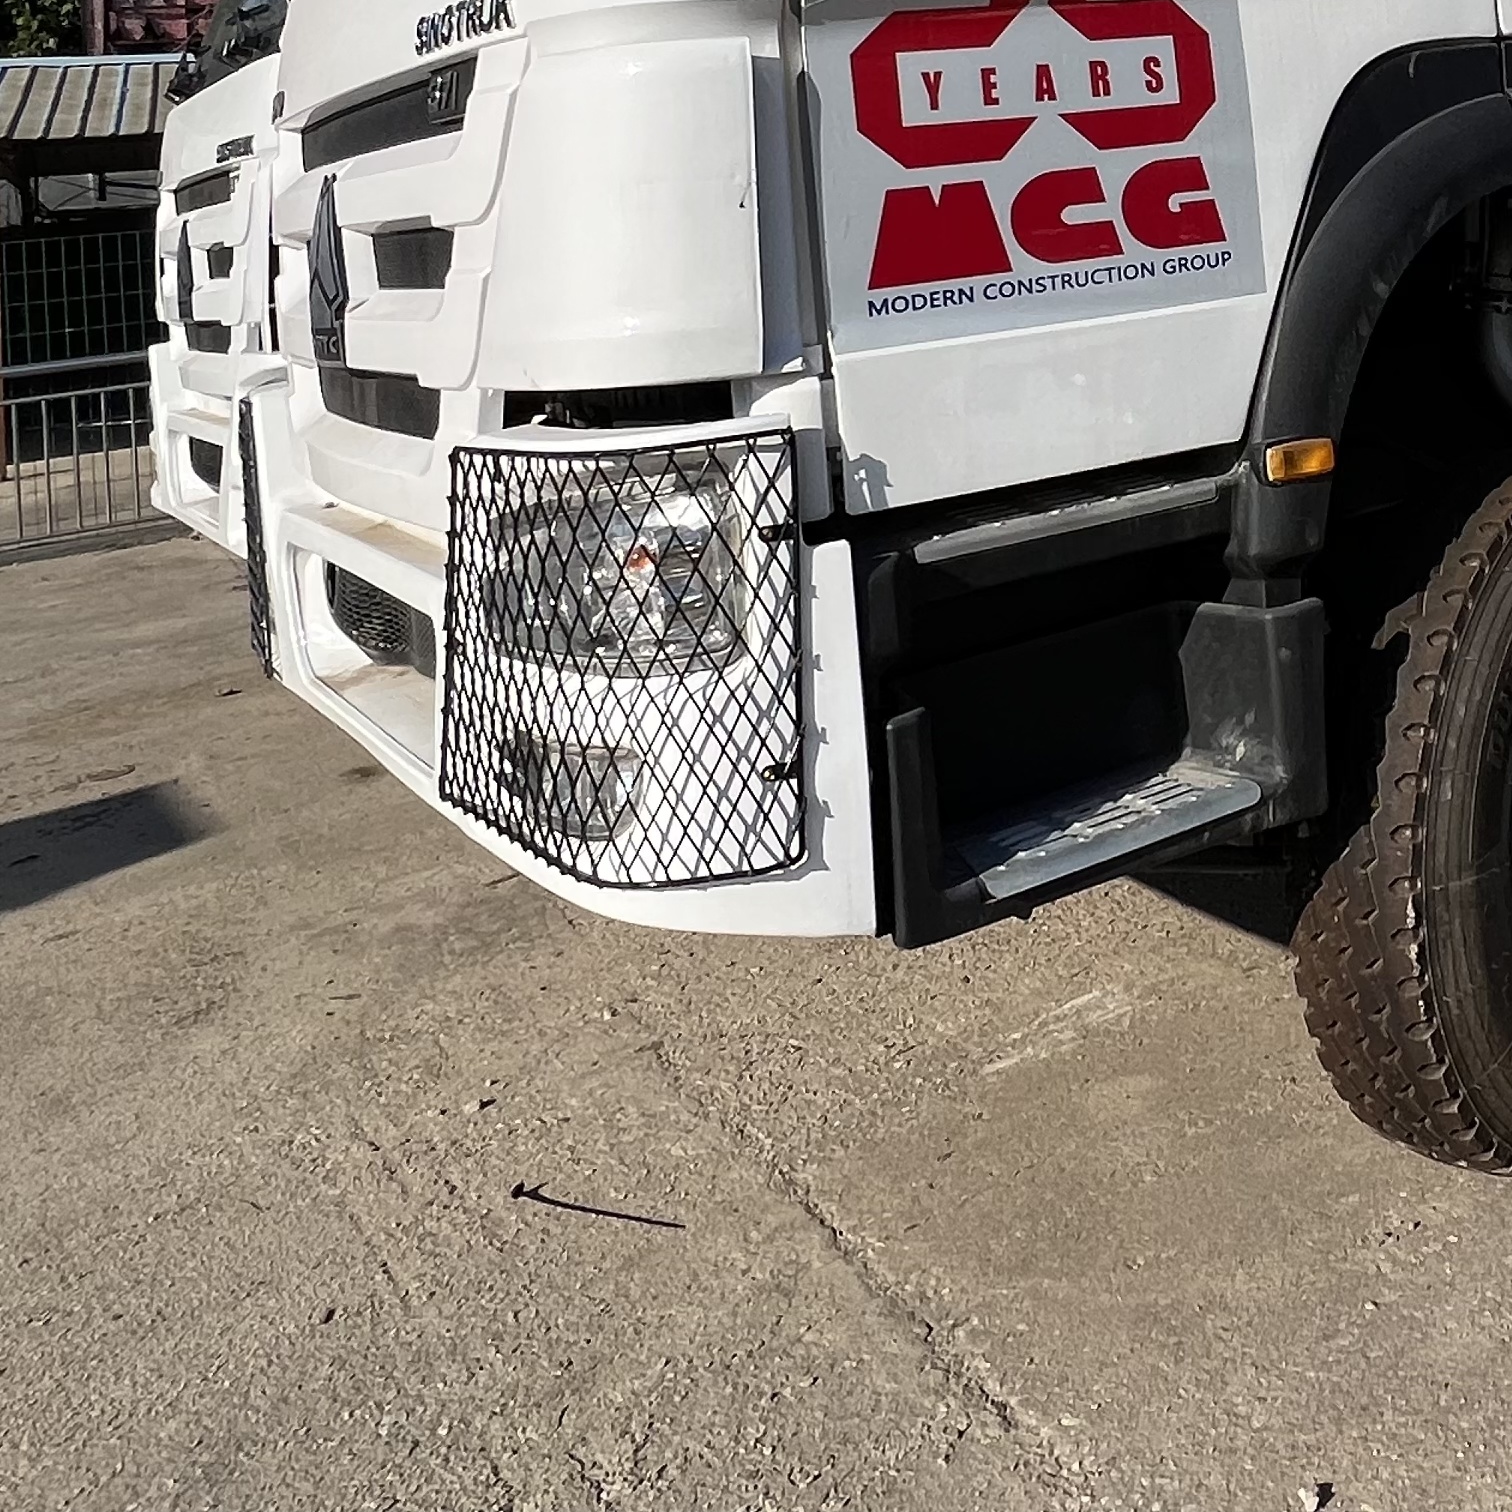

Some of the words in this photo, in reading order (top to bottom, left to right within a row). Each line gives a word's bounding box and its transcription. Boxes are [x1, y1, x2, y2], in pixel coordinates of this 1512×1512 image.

[920, 55, 1165, 111] YEARS
[867, 155, 1227, 291] MCG
[867, 285, 976, 318] MODERN
[982, 260, 1156, 302] CONSTRUCTION
[1161, 249, 1233, 276] GROUP
